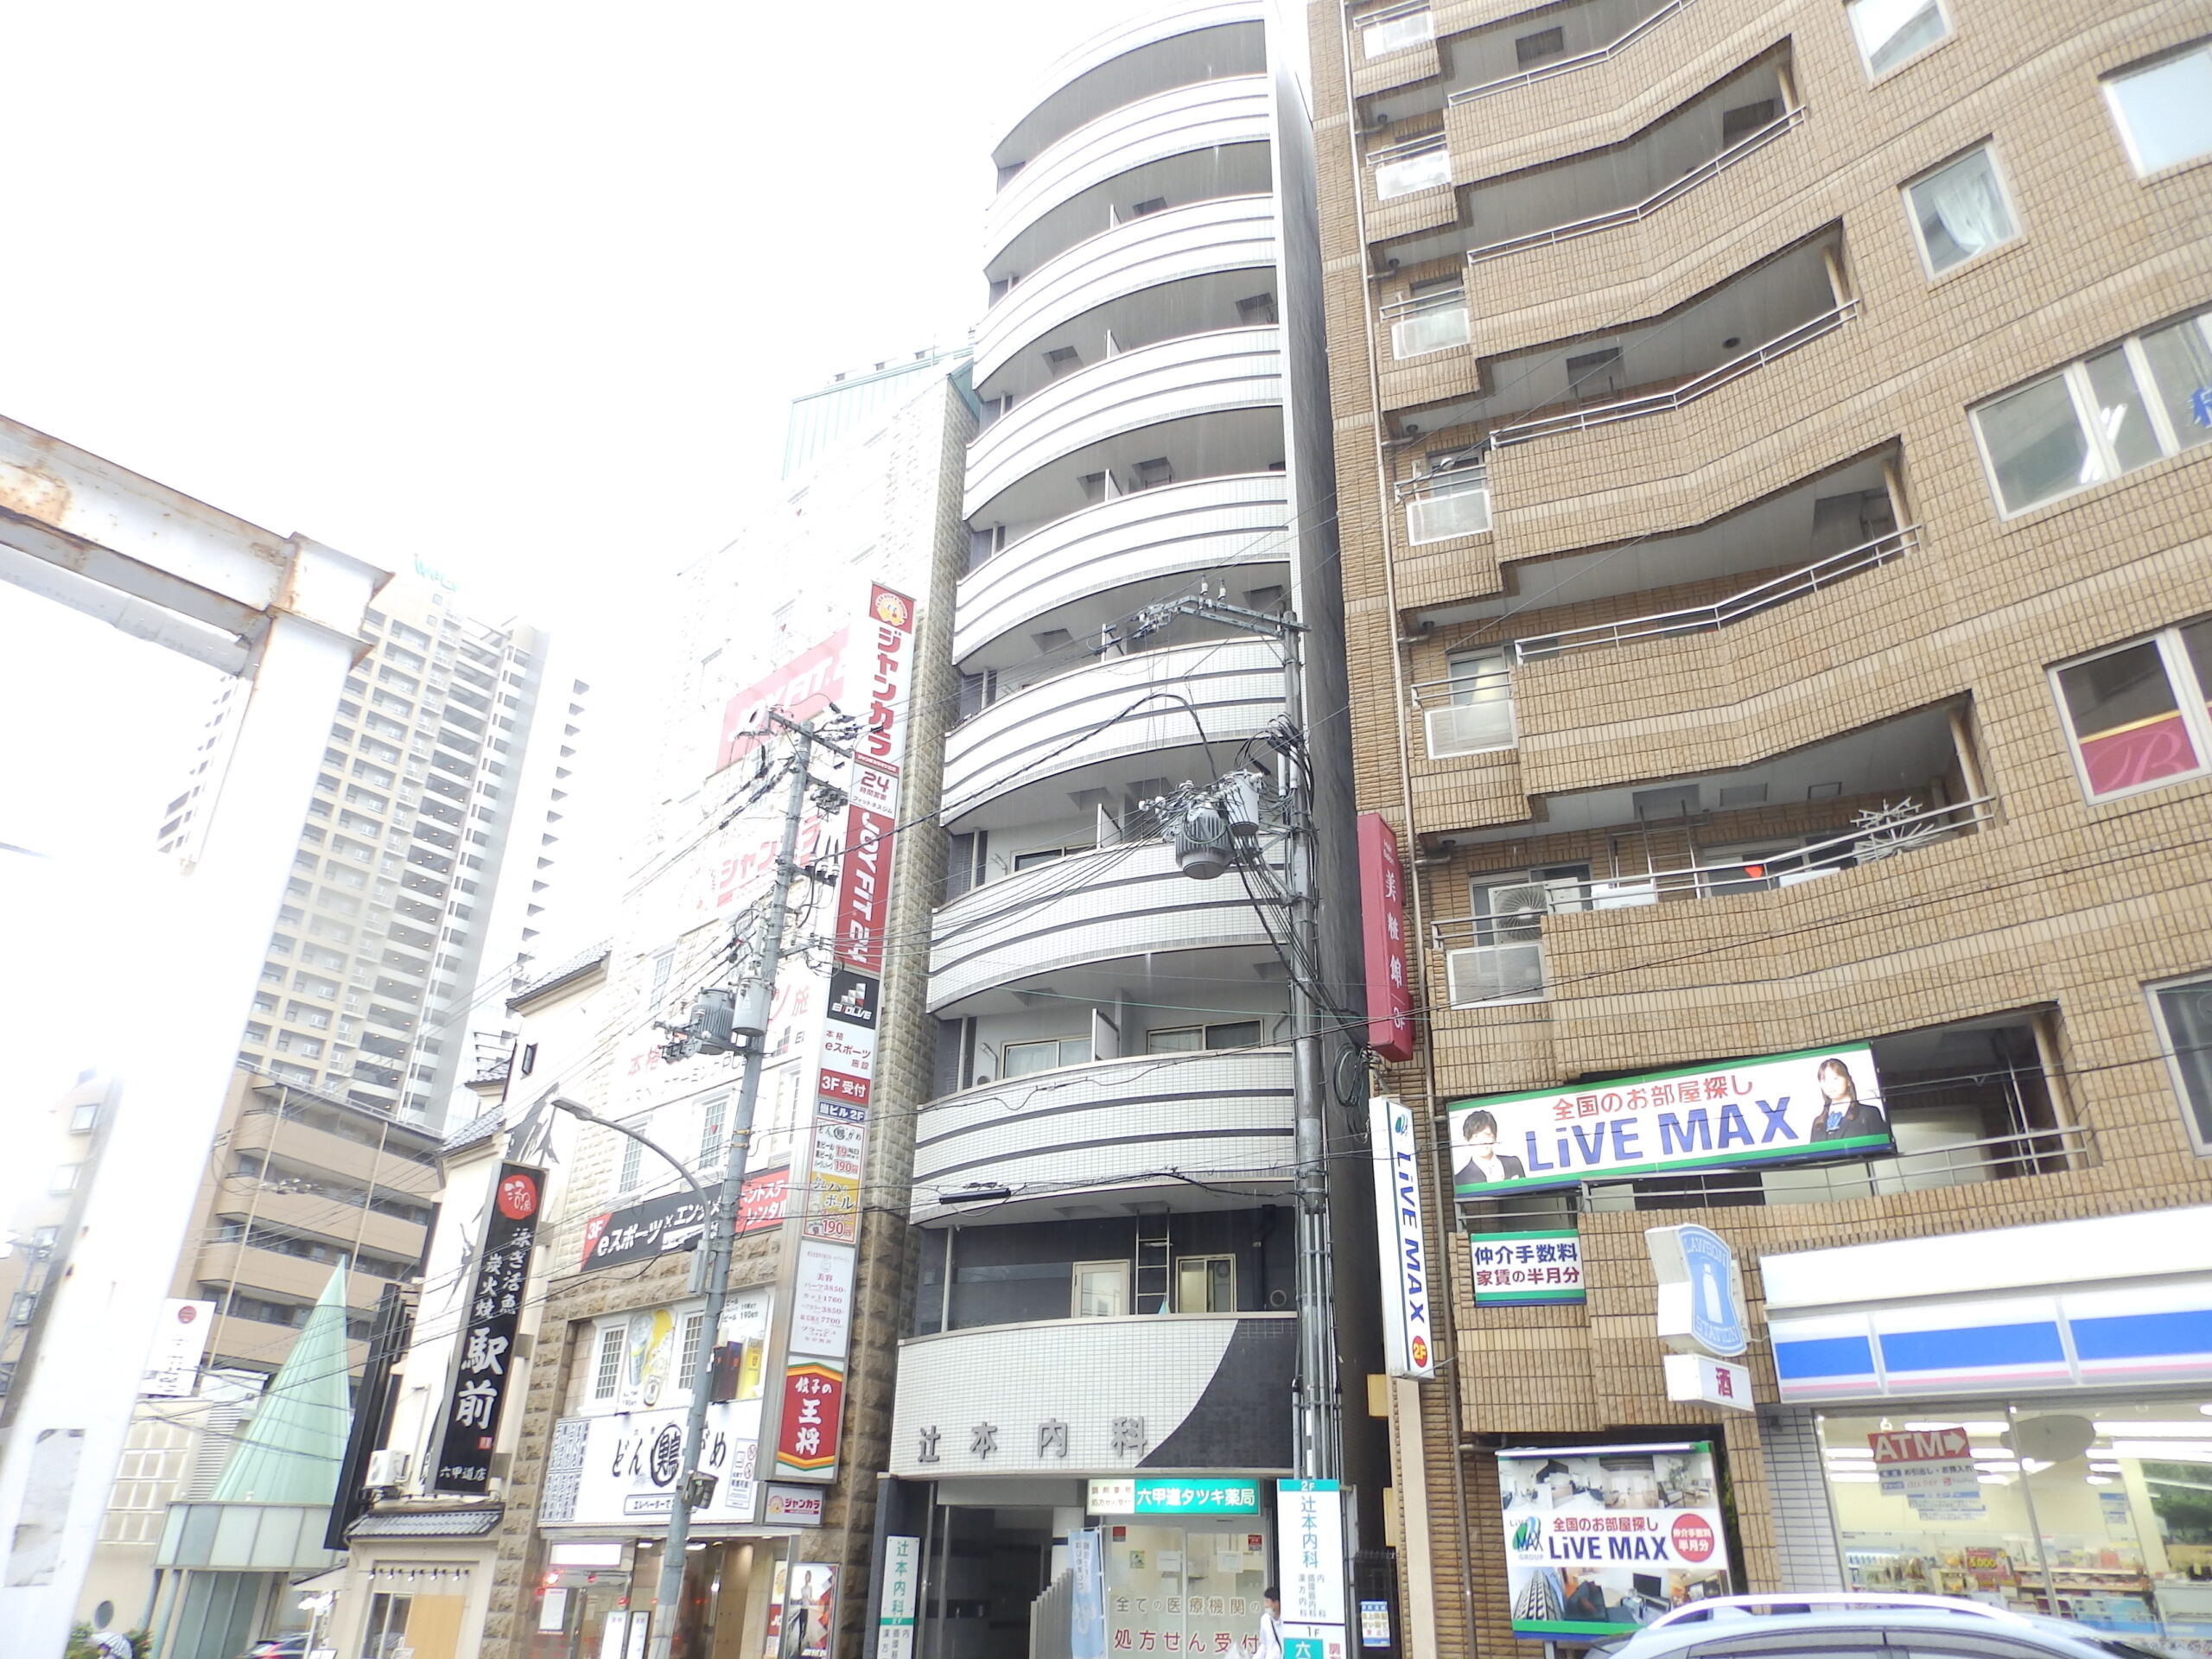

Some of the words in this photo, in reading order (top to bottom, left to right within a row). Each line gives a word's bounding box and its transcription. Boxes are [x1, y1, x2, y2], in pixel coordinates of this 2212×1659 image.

[868, 626, 901, 757] ジャンカラ
[825, 1042, 872, 1059] eスポーツ
[822, 1076, 841, 1091] 3F
[842, 1080, 866, 1098] 受付
[1552, 1074, 1753, 1122] 全国のお部屋探し
[819, 1103, 849, 1117] 当ビル
[849, 1110, 864, 1122] 2F
[1657, 1096, 1800, 1156] MAX
[588, 1220, 604, 1240] 3F
[598, 1217, 664, 1258] eスポーツ
[1474, 1243, 1579, 1266] 仲介手数料
[1685, 1236, 1728, 1268] LAWSON
[1404, 1237, 1426, 1324] MAX
[1476, 1267, 1580, 1287] 家賃の半月分
[1695, 1314, 1739, 1343] STATION
[1413, 1344, 1427, 1362] 2F
[454, 1326, 510, 1430] 駅前
[795, 1376, 833, 1395] 餃子の
[1715, 1366, 1734, 1399] 酒
[795, 1397, 823, 1457] 王将
[917, 1415, 1148, 1463] 辻本内科
[1874, 1431, 1946, 1461] ATM
[439, 1465, 487, 1482] 六甲道店
[1136, 1487, 1255, 1507] 六甲道タツキ薬局
[1300, 1480, 1315, 1491] 2F
[785, 1497, 820, 1510] ジャンカラ
[1300, 1495, 1319, 1569] 辻本内科
[1553, 1516, 1659, 1533] 全国のお部屋探し
[1673, 1527, 1713, 1538] 仲介手数料
[1609, 1535, 1670, 1560] MAX
[1678, 1538, 1710, 1553] 半月分
[890, 1541, 910, 1617] 辻本内科
[1116, 1596, 1261, 1615] 全ての医療機関の
[1114, 1628, 1261, 1655] 処方せん受付
[1306, 1625, 1319, 1637] 1F
